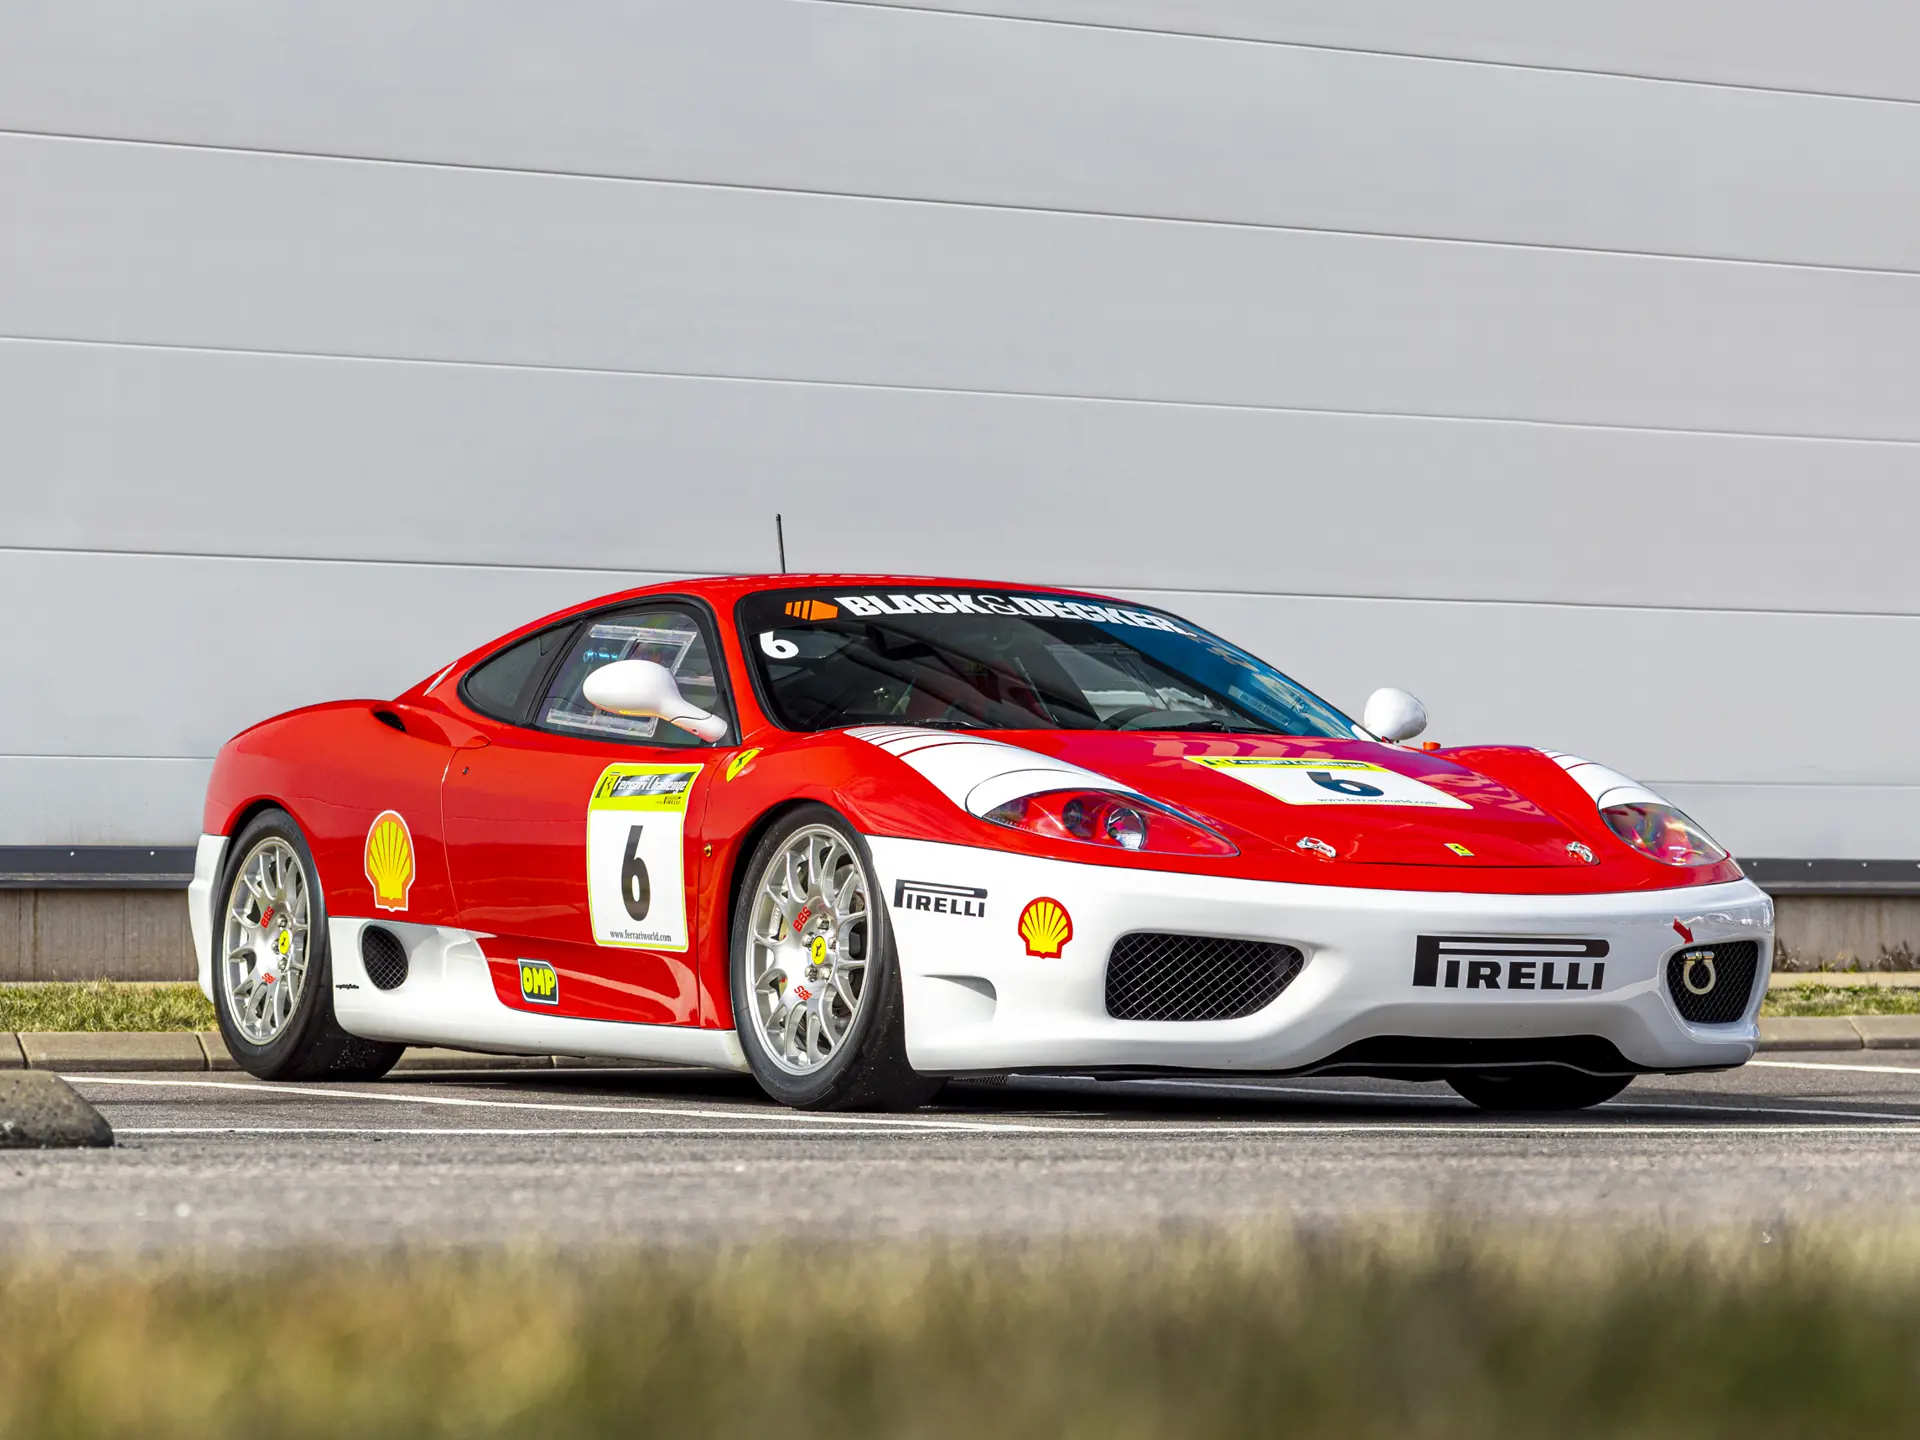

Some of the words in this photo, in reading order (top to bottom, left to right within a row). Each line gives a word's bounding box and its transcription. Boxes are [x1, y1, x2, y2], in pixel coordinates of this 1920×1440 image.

[759, 630, 799, 659] 6
[613, 775, 651, 790] Ferrari
[647, 774, 688, 794] Challenge
[1306, 771, 1384, 797] 6
[621, 825, 650, 921] 6
[893, 879, 988, 918] PIRELLI
[260, 905, 275, 928] BBS
[792, 905, 812, 932] BBS
[610, 929, 672, 942] www.ferrariworld.com
[1412, 935, 1610, 990] PIRELLI
[523, 966, 555, 996] OMP
